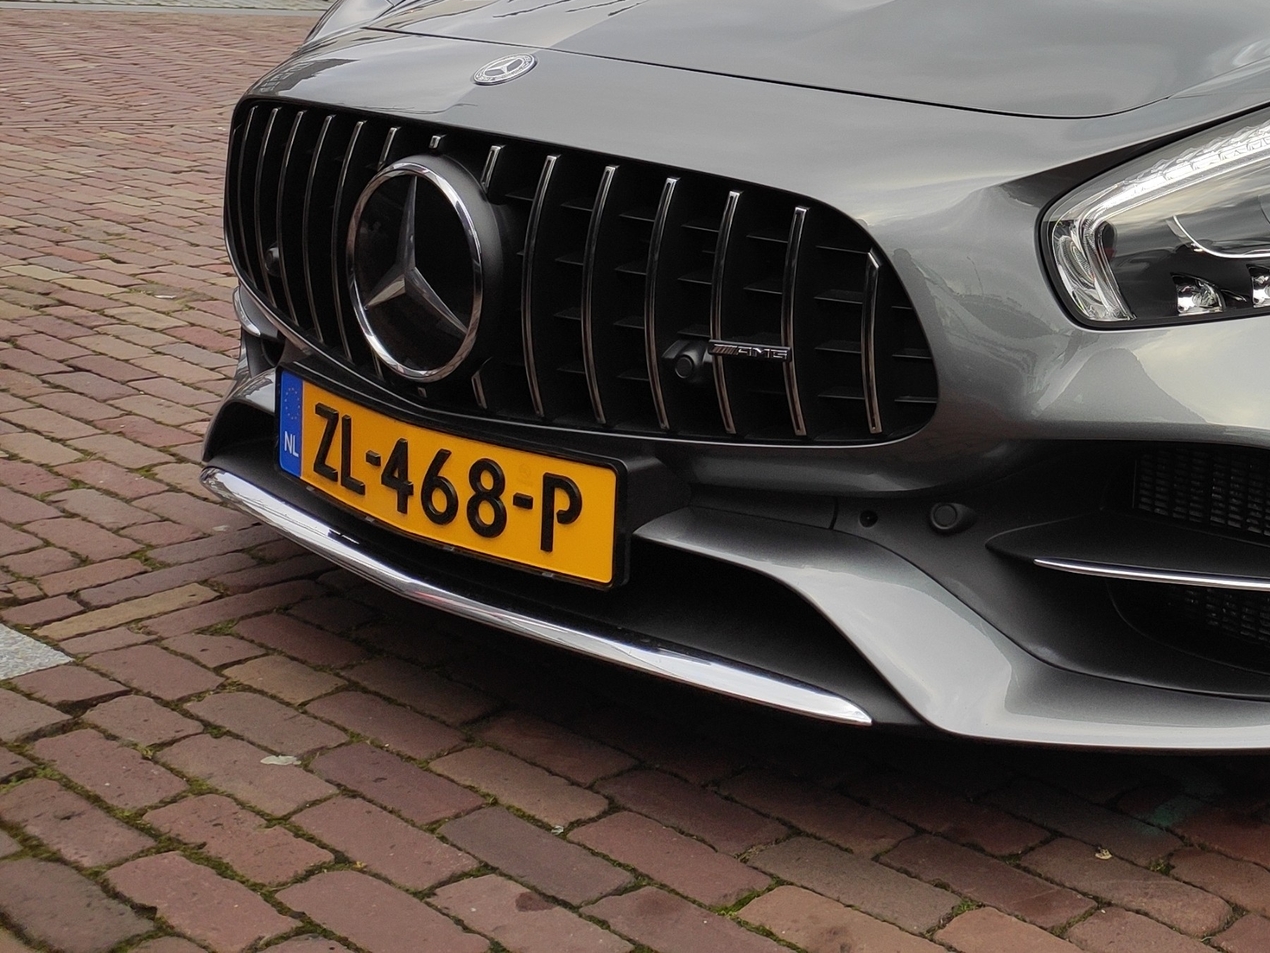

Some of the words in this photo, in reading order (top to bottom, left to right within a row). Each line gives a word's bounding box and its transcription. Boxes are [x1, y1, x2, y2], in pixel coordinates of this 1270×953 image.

[738, 345, 788, 360] AMG
[284, 430, 299, 458] NL
[313, 402, 583, 553] ZL-468-P
